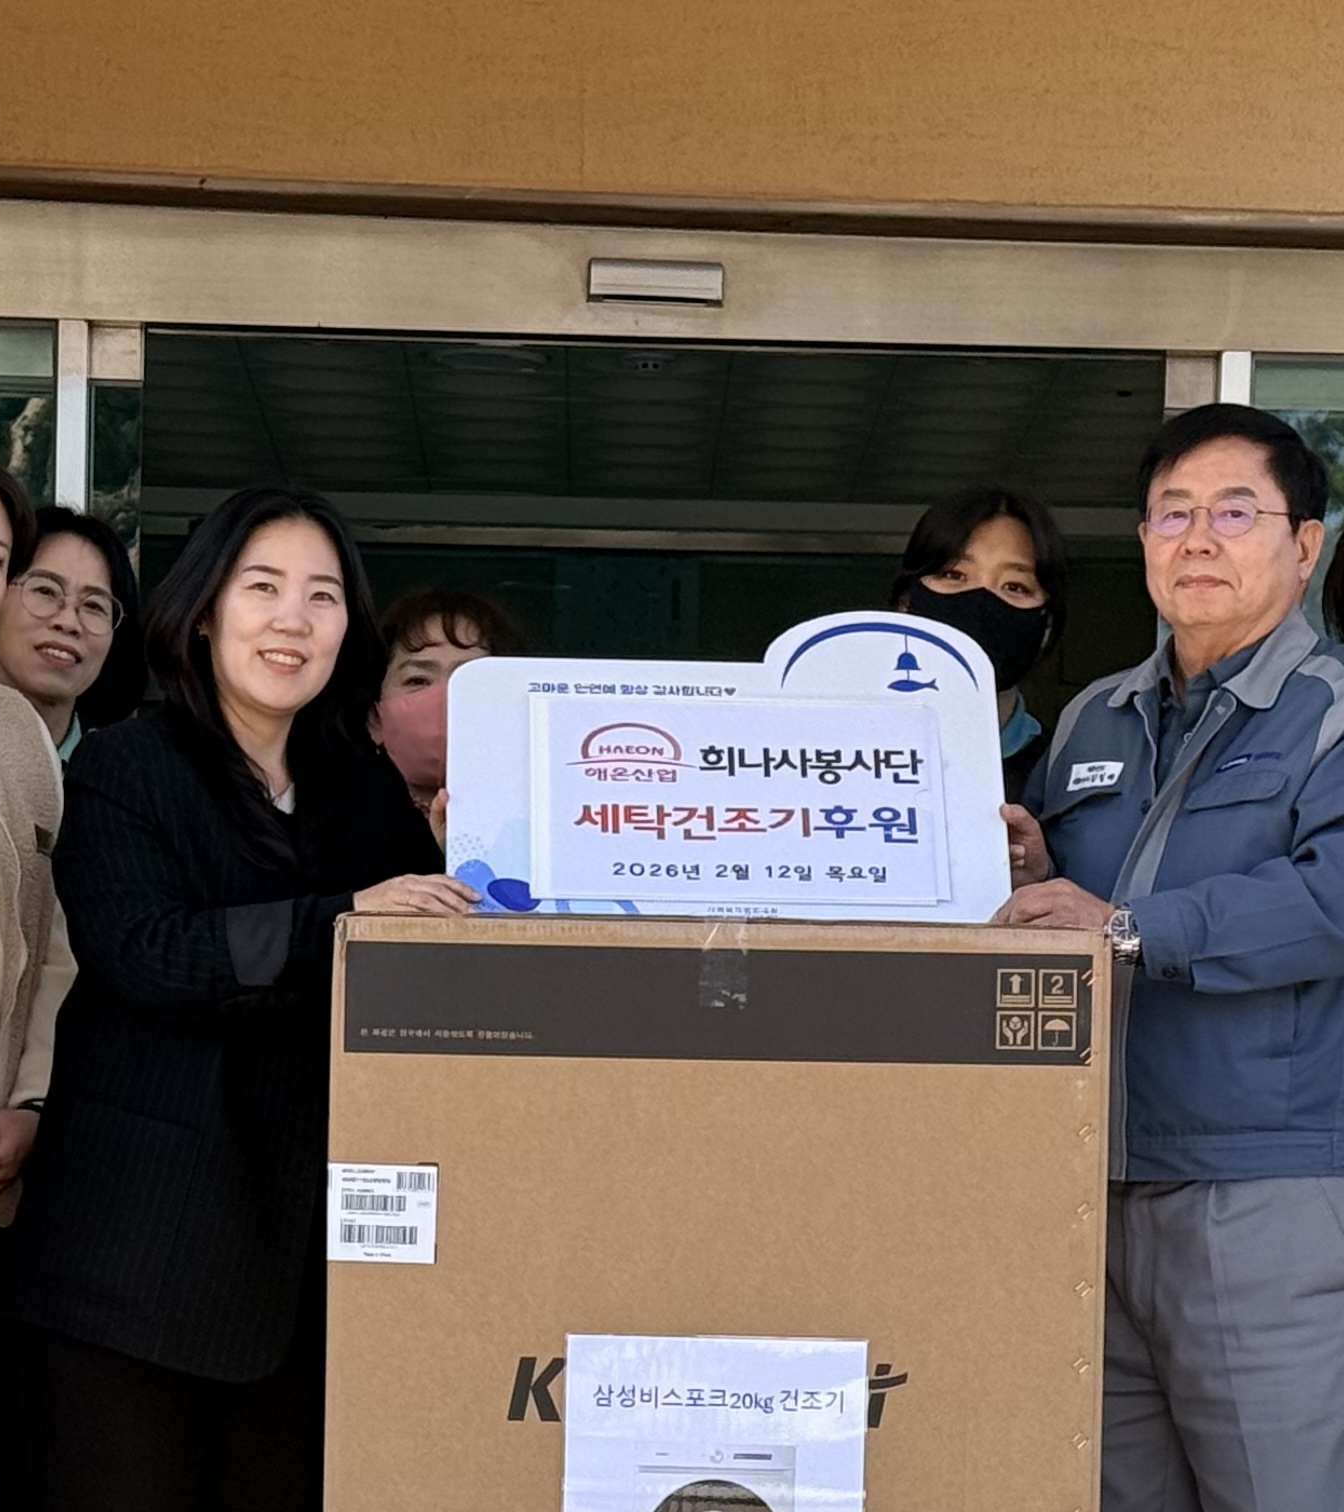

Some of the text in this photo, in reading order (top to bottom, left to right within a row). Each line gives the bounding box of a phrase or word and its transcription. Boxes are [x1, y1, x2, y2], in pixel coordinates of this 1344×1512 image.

[527, 682, 570, 694] 고마운
[598, 745, 665, 757] HAEON
[584, 766, 678, 783] 해온산업
[699, 745, 923, 785] 희나사봉사단
[573, 803, 919, 844] 세탁건조기후원
[613, 862, 887, 883] 2026년 2월 12일 목요일
[593, 1384, 775, 1414] 삼성비스포크20kg
[779, 1389, 845, 1414] 건조기
